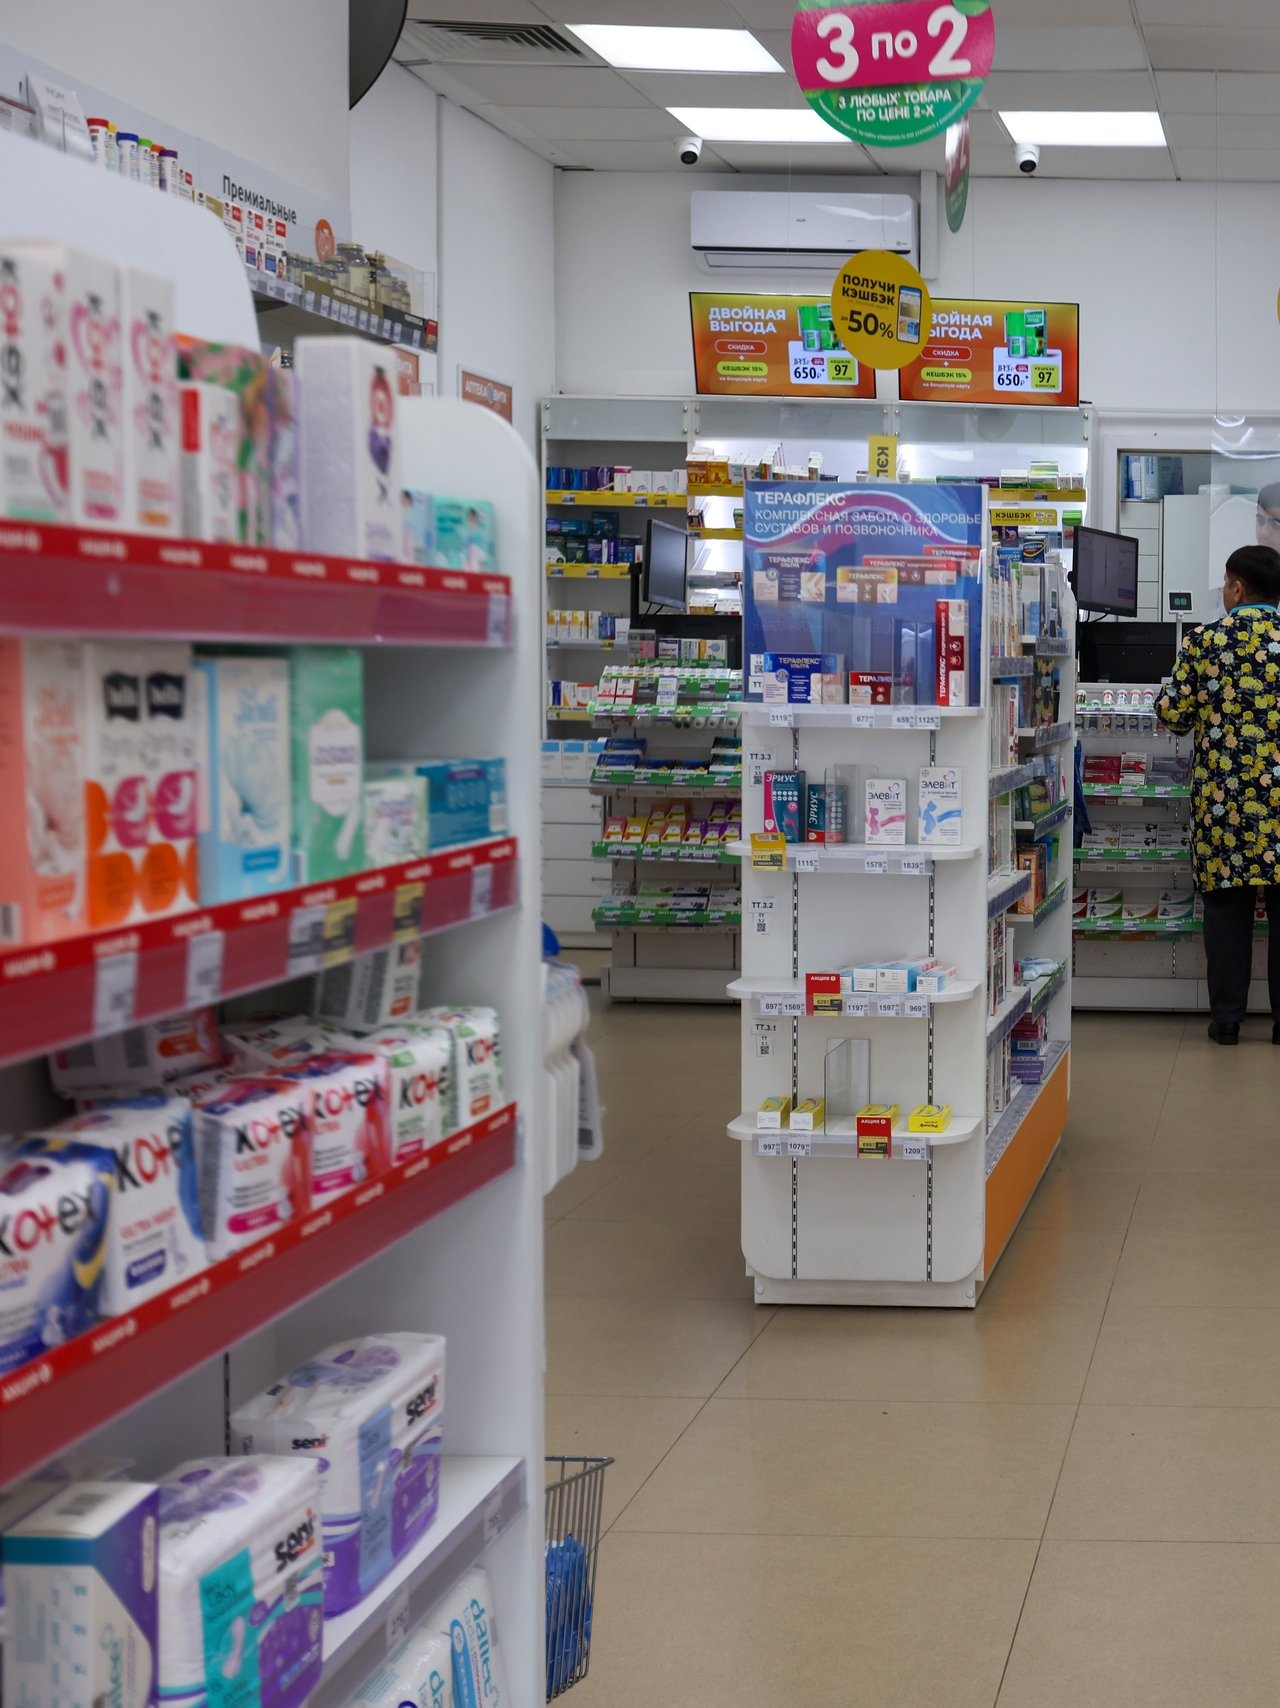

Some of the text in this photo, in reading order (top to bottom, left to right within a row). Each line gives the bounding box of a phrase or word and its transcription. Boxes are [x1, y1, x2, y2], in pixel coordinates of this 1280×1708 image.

[816, 4, 972, 83] 3 по 2
[838, 96, 847, 109] 3
[904, 88, 952, 104] ТОВАРА
[857, 109, 875, 122] ПО
[879, 106, 910, 122] ЦЕНЕ
[222, 174, 298, 226] Премиальные
[842, 274, 896, 294] ПОЛУЧИ
[841, 286, 896, 306] КЭШБЭК
[708, 305, 786, 321] ДВОЙНАЯ
[931, 311, 993, 327] ВОЙНАЯ
[709, 321, 777, 334] ВЫГОДА
[847, 309, 894, 339] 50%
[928, 326, 983, 340] ЫГОДА
[727, 343, 755, 351] СКИДКА
[932, 349, 960, 357] СКИДКА
[834, 365, 848, 376] 97
[1038, 372, 1053, 384] 97
[465, 380, 507, 404] АПТЕКА ВИТА
[754, 491, 846, 506] ТЕРАФЛЕКС
[755, 510, 982, 525] КОМПЛЕКСНАЯ ЗАБОТА О ЗДОРОВЬЕ
[755, 522, 939, 537] СУСТАВОВ И ПОЗВОНОЧНИКА
[768, 556, 810, 565] ТЕРАФЛЕКС
[870, 560, 906, 568] ТЕРАФЛЕКС
[848, 572, 886, 580] ТЕРАФЛЕКС
[778, 657, 821, 665] ТЕРАФЛЕКС
[858, 675, 893, 683] ТЕРАЛИВ
[750, 753, 771, 761] ТТ.3.3
[766, 774, 795, 783] ЭРИУС
[921, 781, 956, 789] ЭЛЕВИТ
[868, 791, 900, 800] ЭЛЕВИТ
[809, 791, 818, 825] ЭРИУС
[784, 1003, 801, 1011] 1569
[755, 1023, 777, 1032] ТТ.3.1
[904, 1147, 921, 1155] 1209
[406, 1374, 438, 1426] seni
[292, 1434, 329, 1451] seni
[274, 1509, 316, 1574] seni
